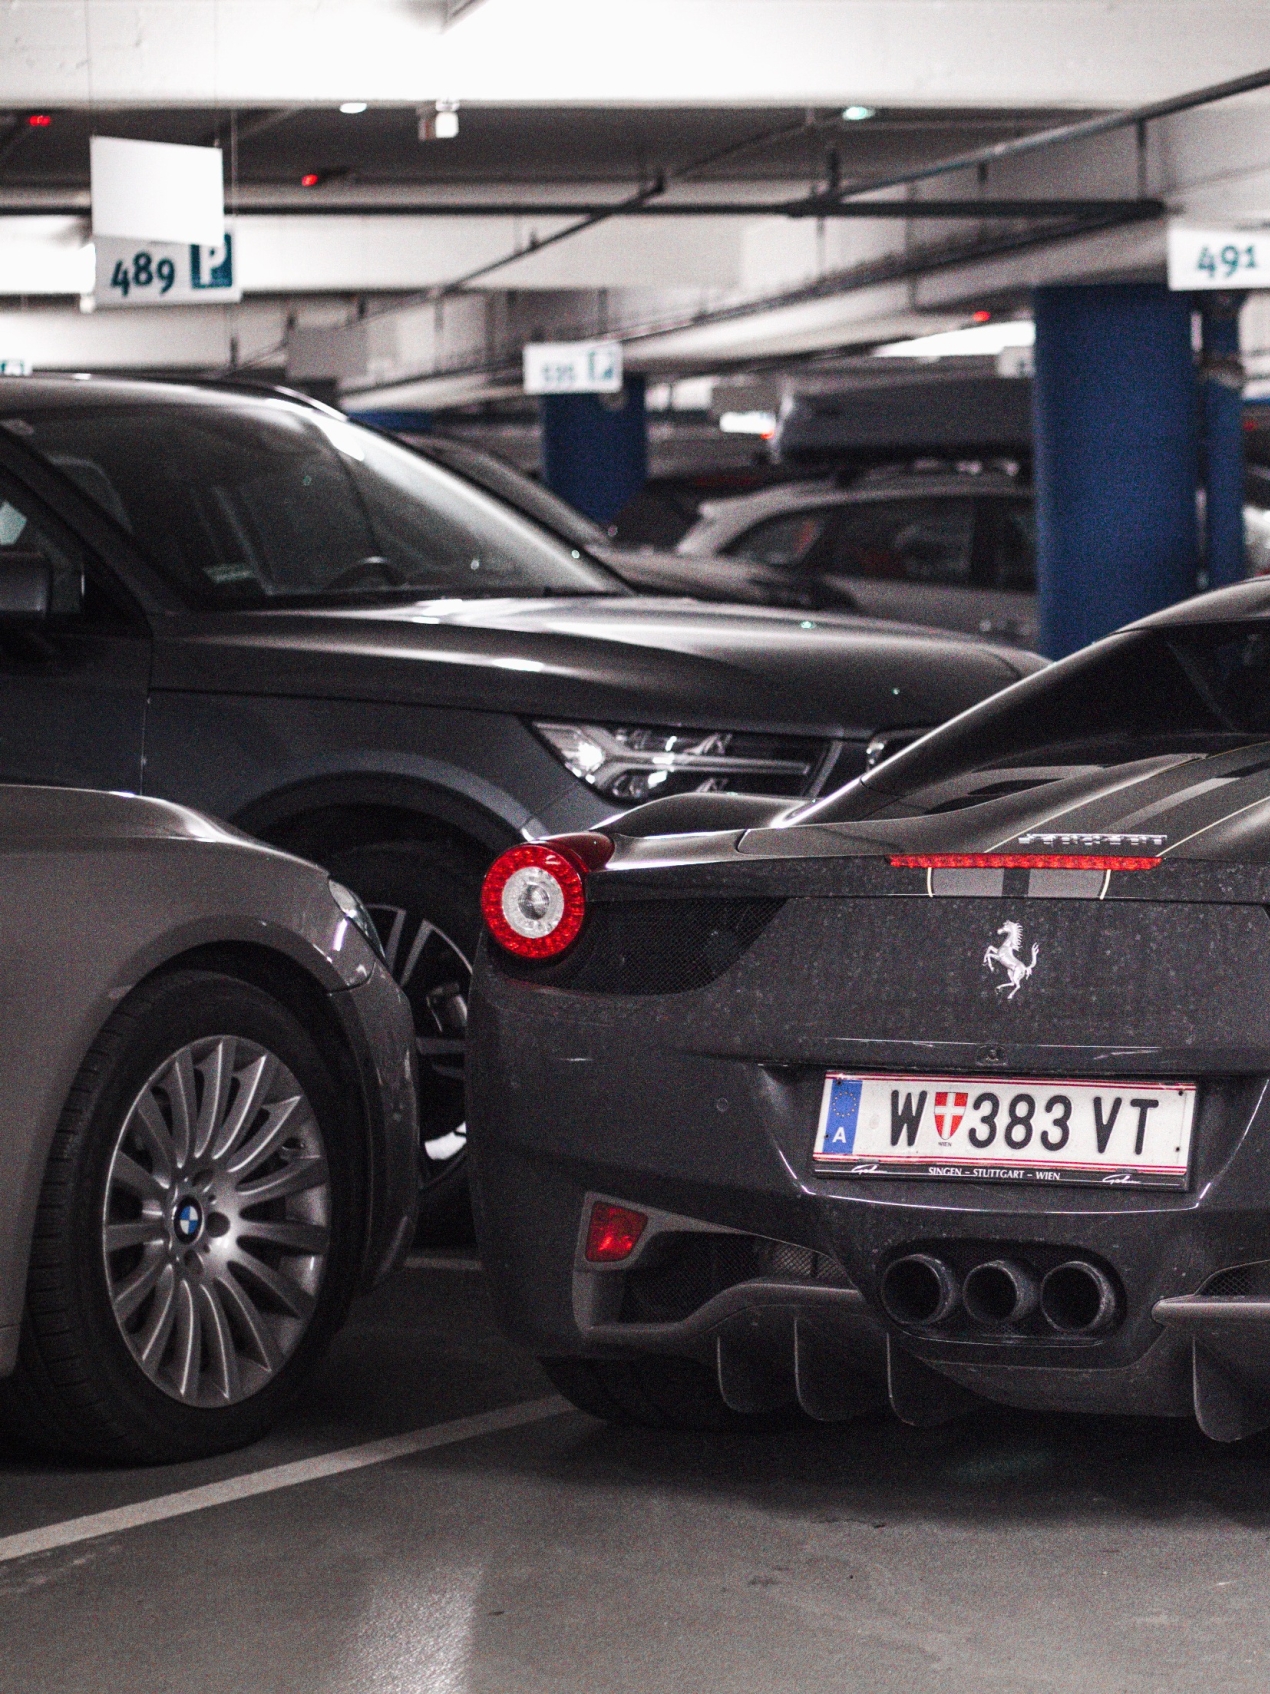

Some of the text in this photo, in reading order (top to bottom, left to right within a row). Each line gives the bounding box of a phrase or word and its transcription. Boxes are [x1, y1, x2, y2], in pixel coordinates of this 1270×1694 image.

[110, 251, 176, 297] 489
[1197, 245, 1256, 278] 491
[832, 1126, 847, 1143] A
[890, 1090, 1160, 1155] W 383 VT
[928, 1166, 963, 1177] SINGEN
[973, 1168, 1026, 1181] STUTTGART
[1035, 1171, 1061, 1181] WIEN
